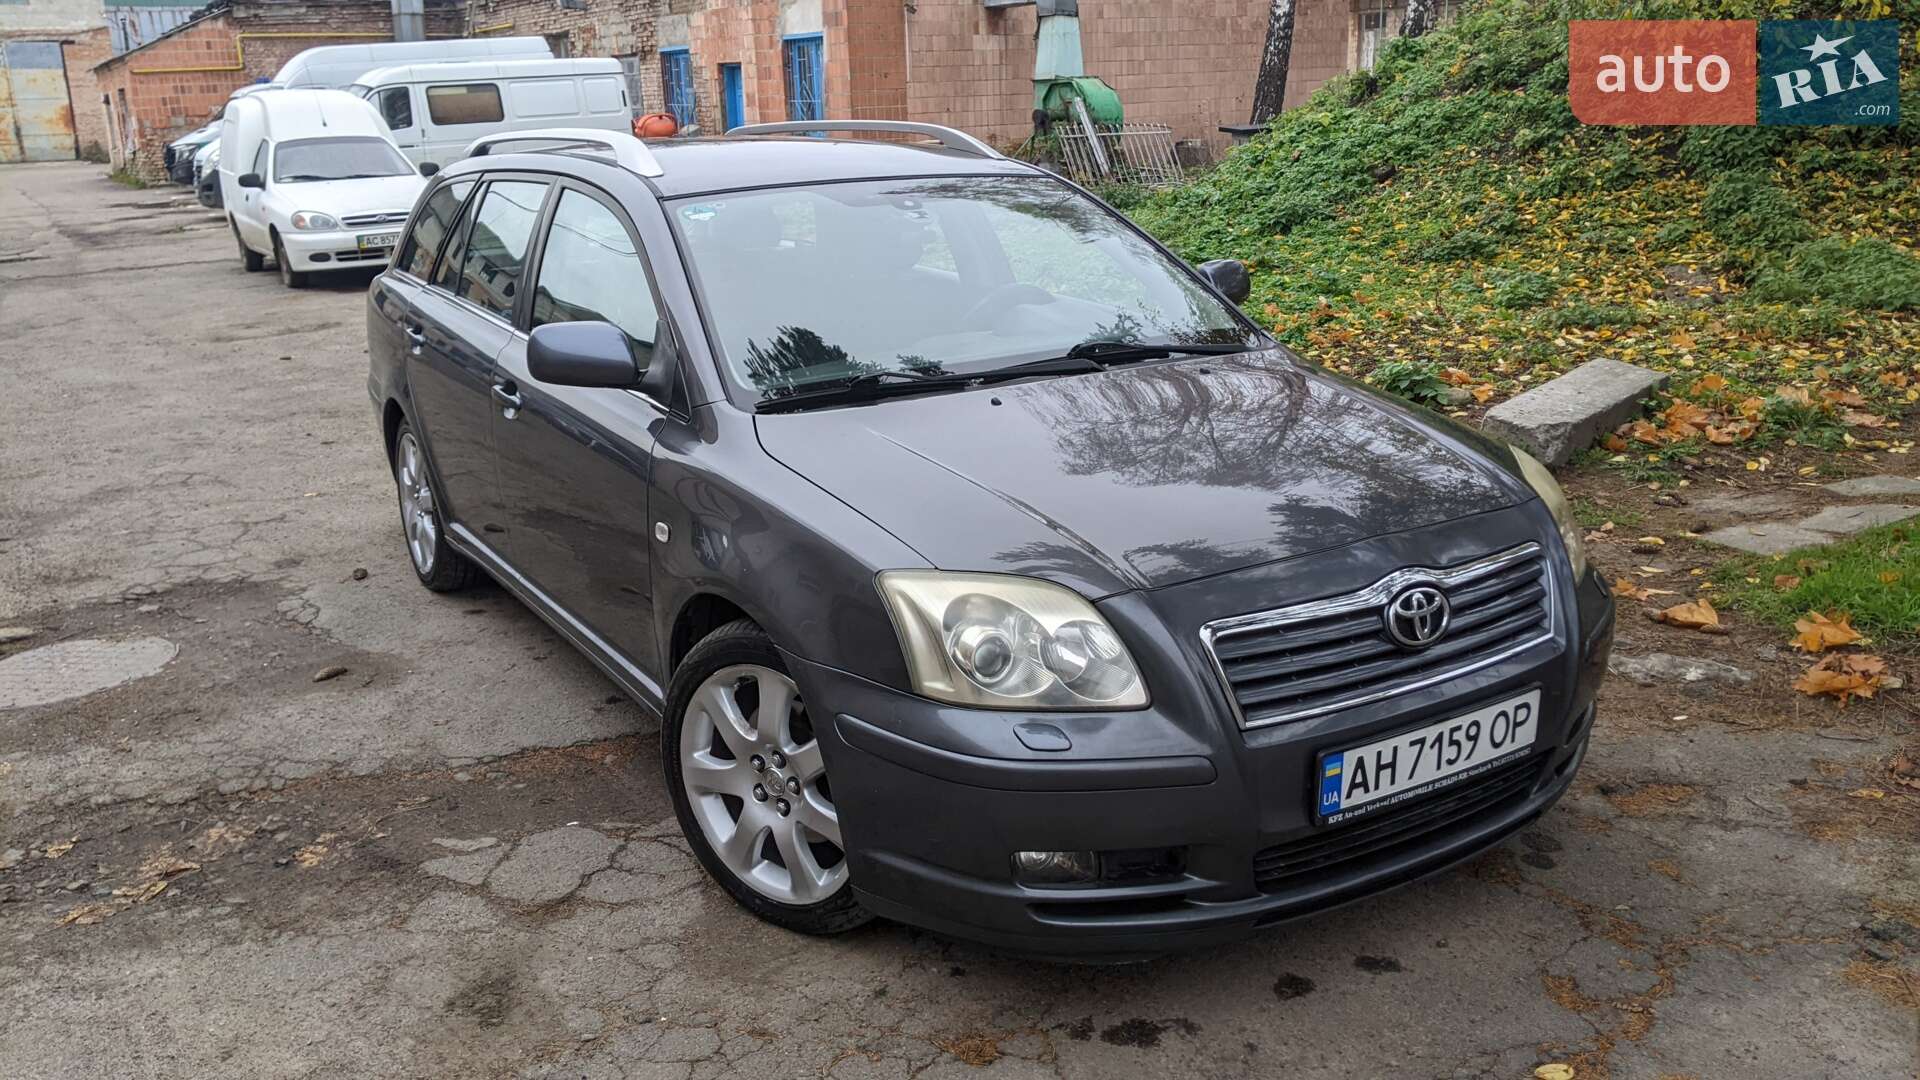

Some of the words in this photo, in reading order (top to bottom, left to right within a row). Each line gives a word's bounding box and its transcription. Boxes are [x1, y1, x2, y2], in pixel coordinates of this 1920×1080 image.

[366, 236, 379, 246] AC
[1345, 745, 1398, 800] AH
[1407, 719, 1481, 781] 7159
[1489, 701, 1532, 749] OP
[1323, 791, 1339, 806] UA
